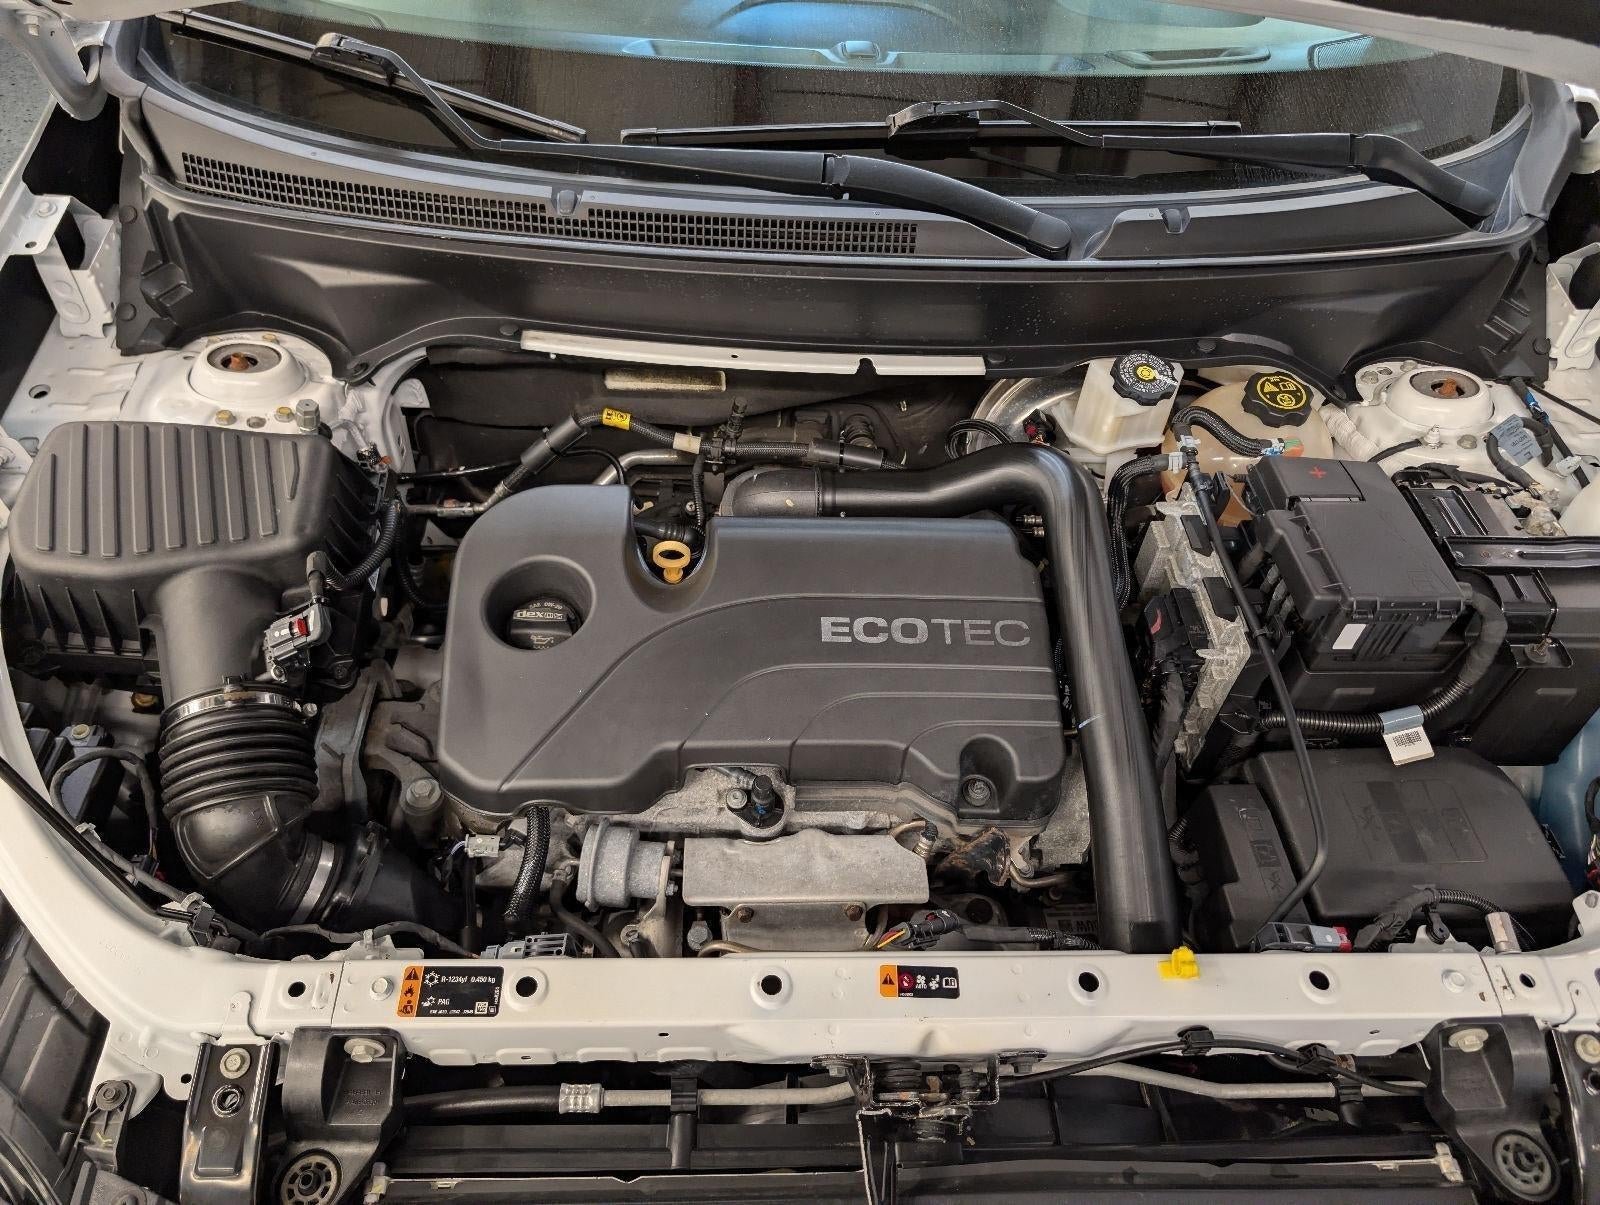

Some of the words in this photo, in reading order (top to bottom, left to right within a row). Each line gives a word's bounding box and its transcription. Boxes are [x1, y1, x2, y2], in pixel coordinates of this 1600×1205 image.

[820, 616, 1031, 647] ECOTEC
[441, 975, 468, 984] R-1234yf
[488, 975, 496, 984] kg
